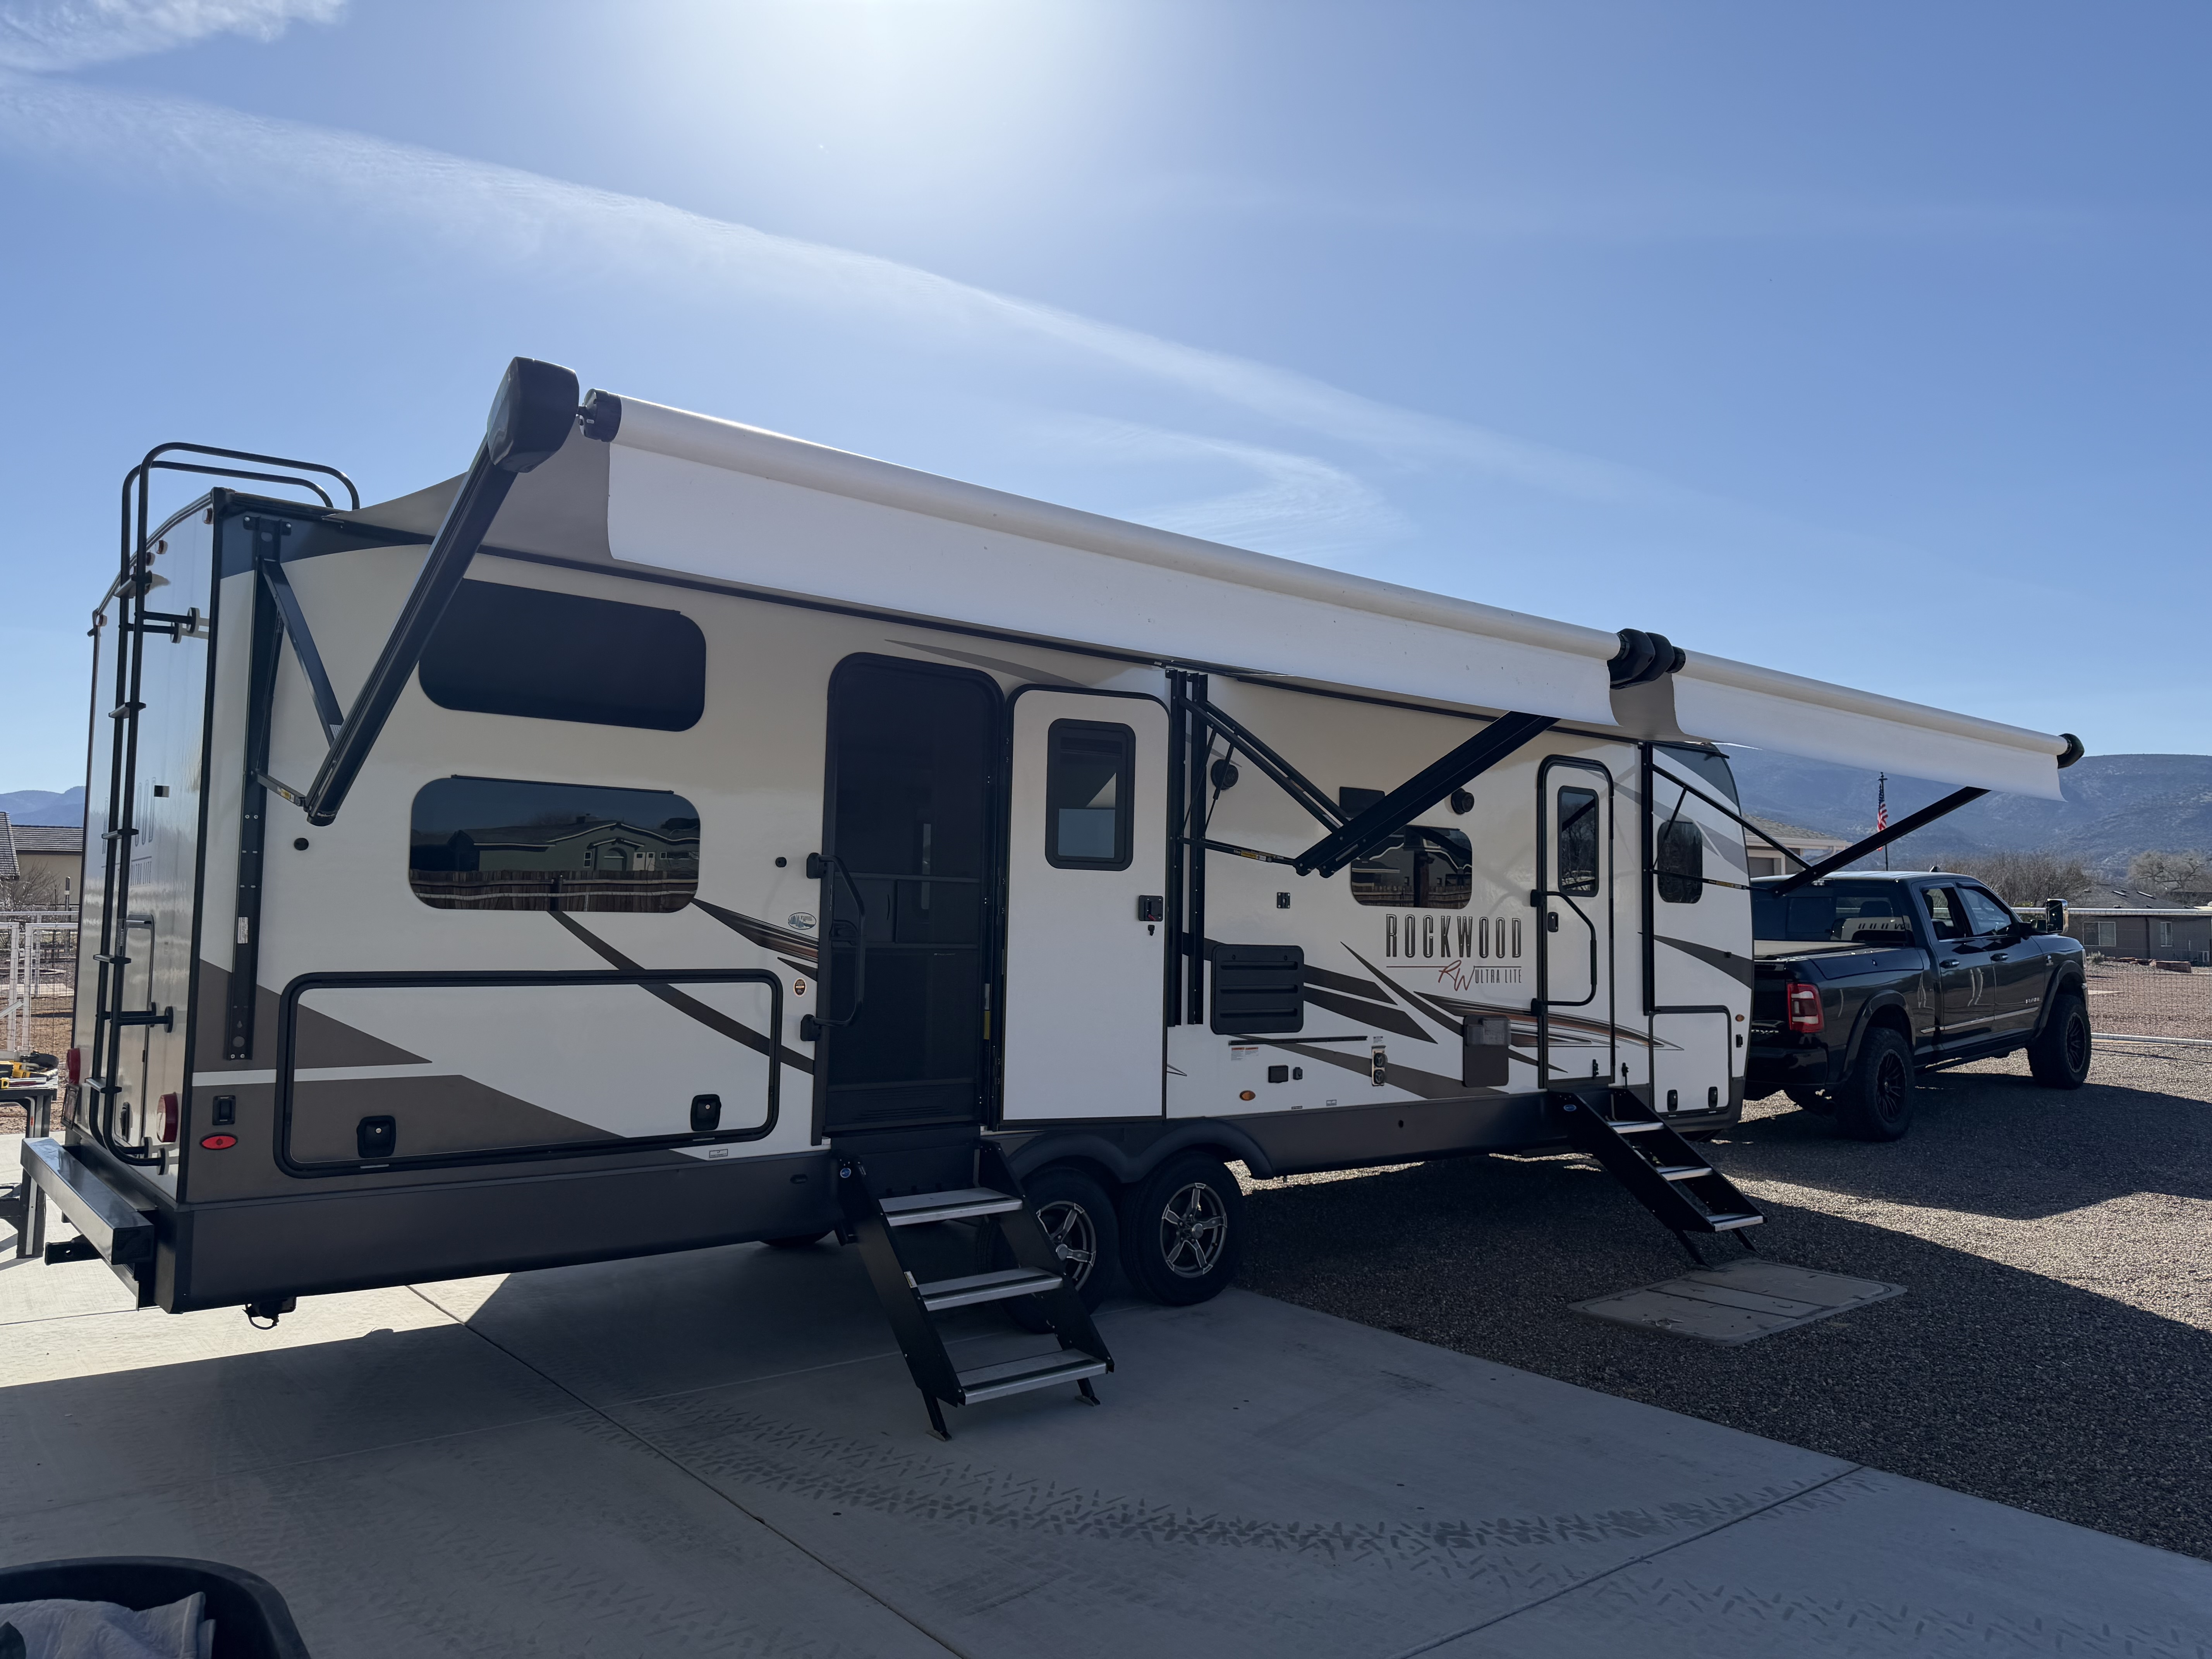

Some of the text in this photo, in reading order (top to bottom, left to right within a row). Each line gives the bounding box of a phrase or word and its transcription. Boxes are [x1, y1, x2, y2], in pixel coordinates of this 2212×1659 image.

[1386, 914, 1522, 958] ROCKWOOD
[1438, 959, 1475, 991] RW
[1475, 969, 1522, 984] ULTRA LITE
